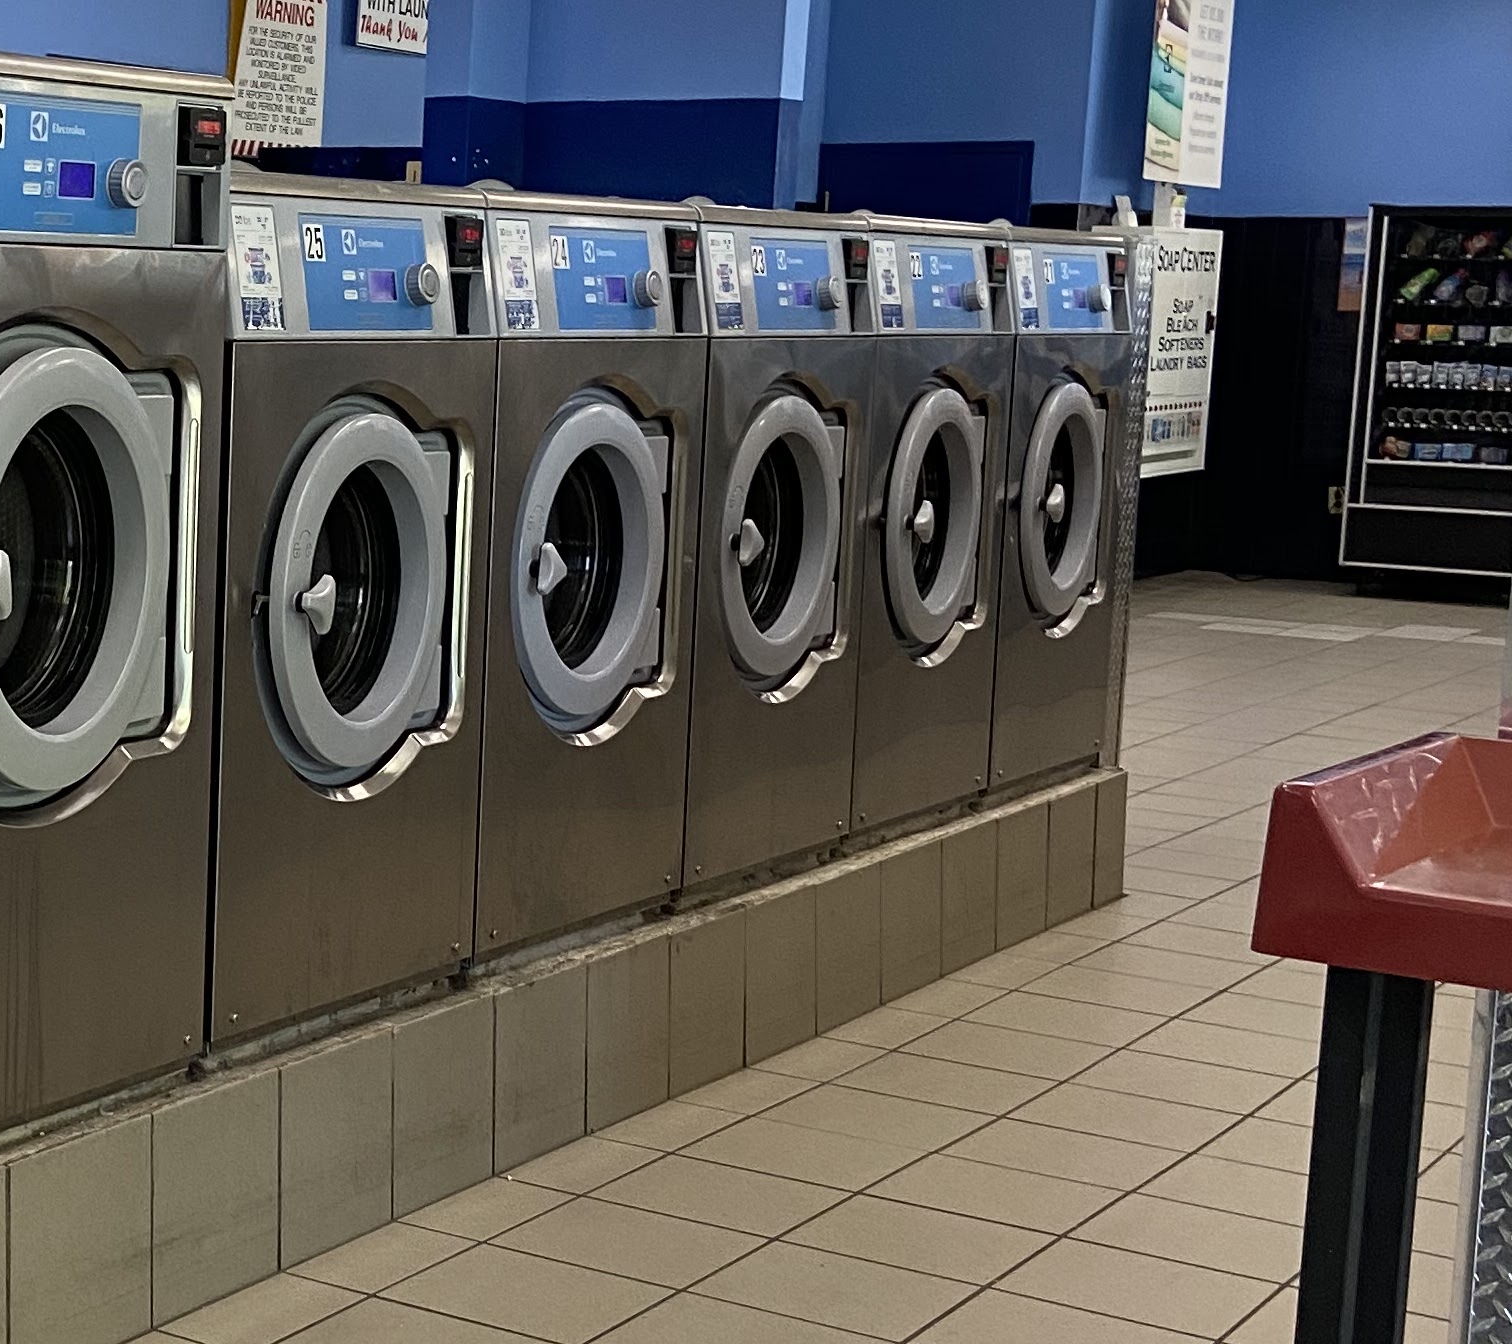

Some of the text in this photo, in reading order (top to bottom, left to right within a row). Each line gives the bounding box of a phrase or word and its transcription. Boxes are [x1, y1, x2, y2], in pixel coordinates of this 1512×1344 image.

[361, 14, 393, 43] Thank
[305, 226, 324, 259] 25
[552, 238, 568, 267] 24
[1157, 245, 1216, 273] SOAP CENTER
[1172, 298, 1194, 314] SOAP
[1166, 316, 1198, 333] BLEACH
[1158, 336, 1205, 352] SOFTENERS
[1150, 355, 1208, 371] LAUNDRY BAGS
